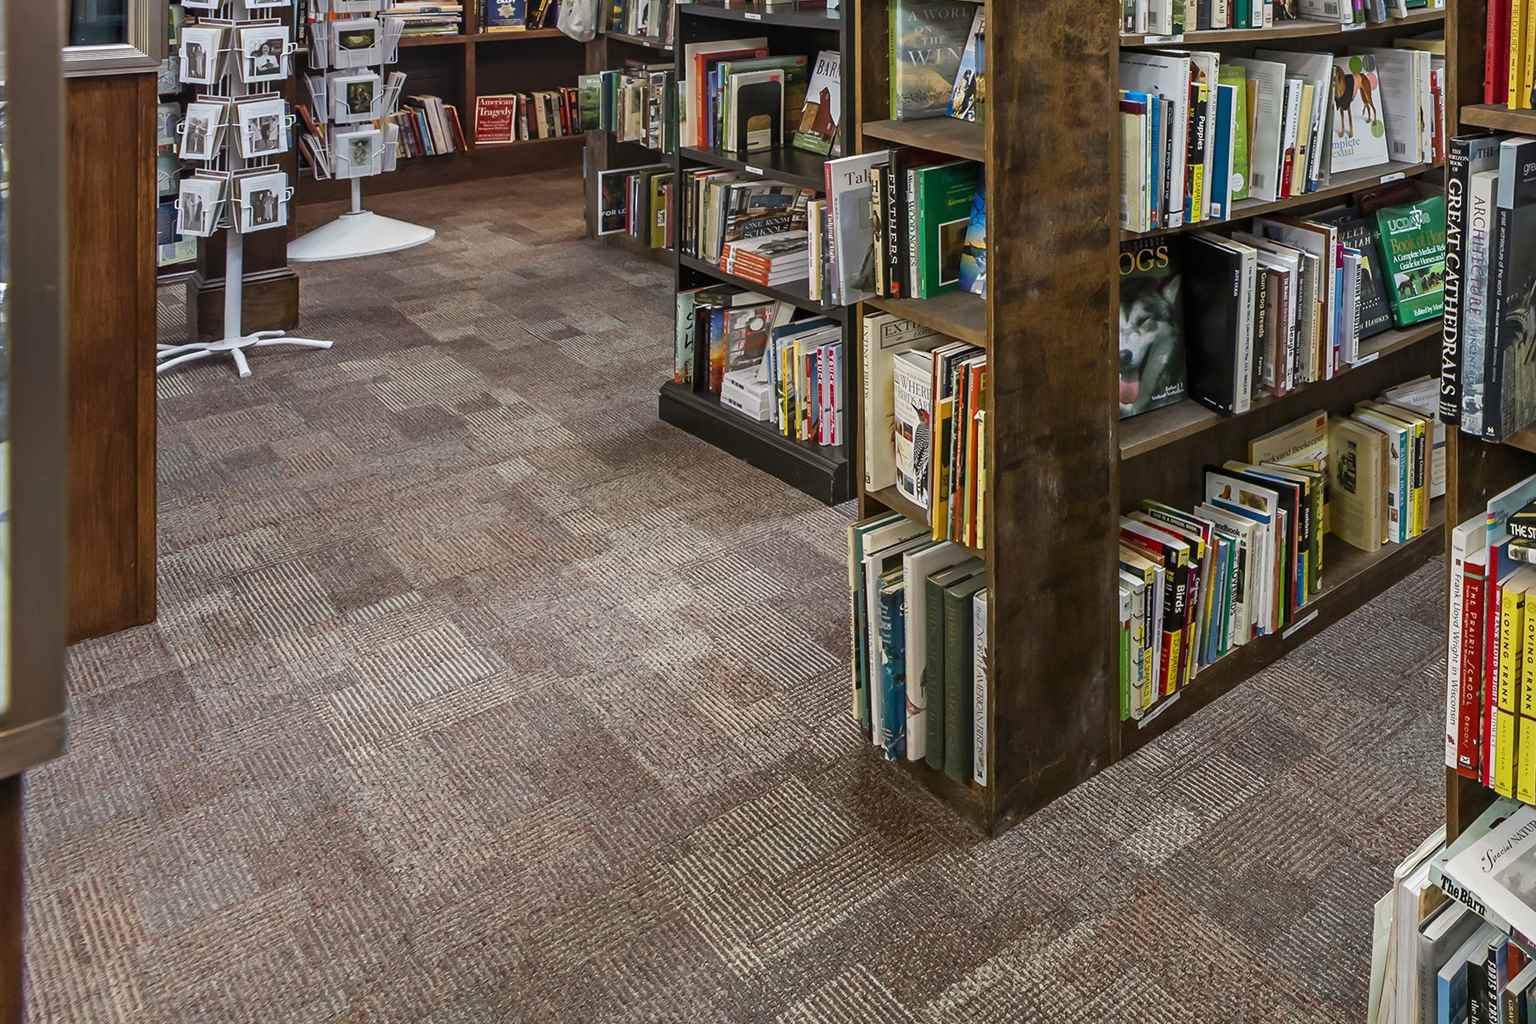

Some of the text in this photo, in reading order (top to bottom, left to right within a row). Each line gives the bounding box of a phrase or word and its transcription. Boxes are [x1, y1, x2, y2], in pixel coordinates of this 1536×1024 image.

[479, 106, 512, 119] Tragedy
[1119, 245, 1170, 276] OGS
[1440, 178, 1465, 397] GREAT CATHEDRALS
[1509, 523, 1529, 537] THE
[1174, 584, 1185, 615] Birds
[1454, 598, 1463, 627] Lloyd
[1453, 626, 1462, 661] Wright
[1465, 585, 1479, 707] THE PRAIRIE SCHOOL
[1500, 611, 1511, 705] LOVING FRANK
[1524, 617, 1536, 711] LOVING FRANK
[1449, 673, 1459, 727] Wisconsin
[1440, 874, 1488, 917] The Barn
